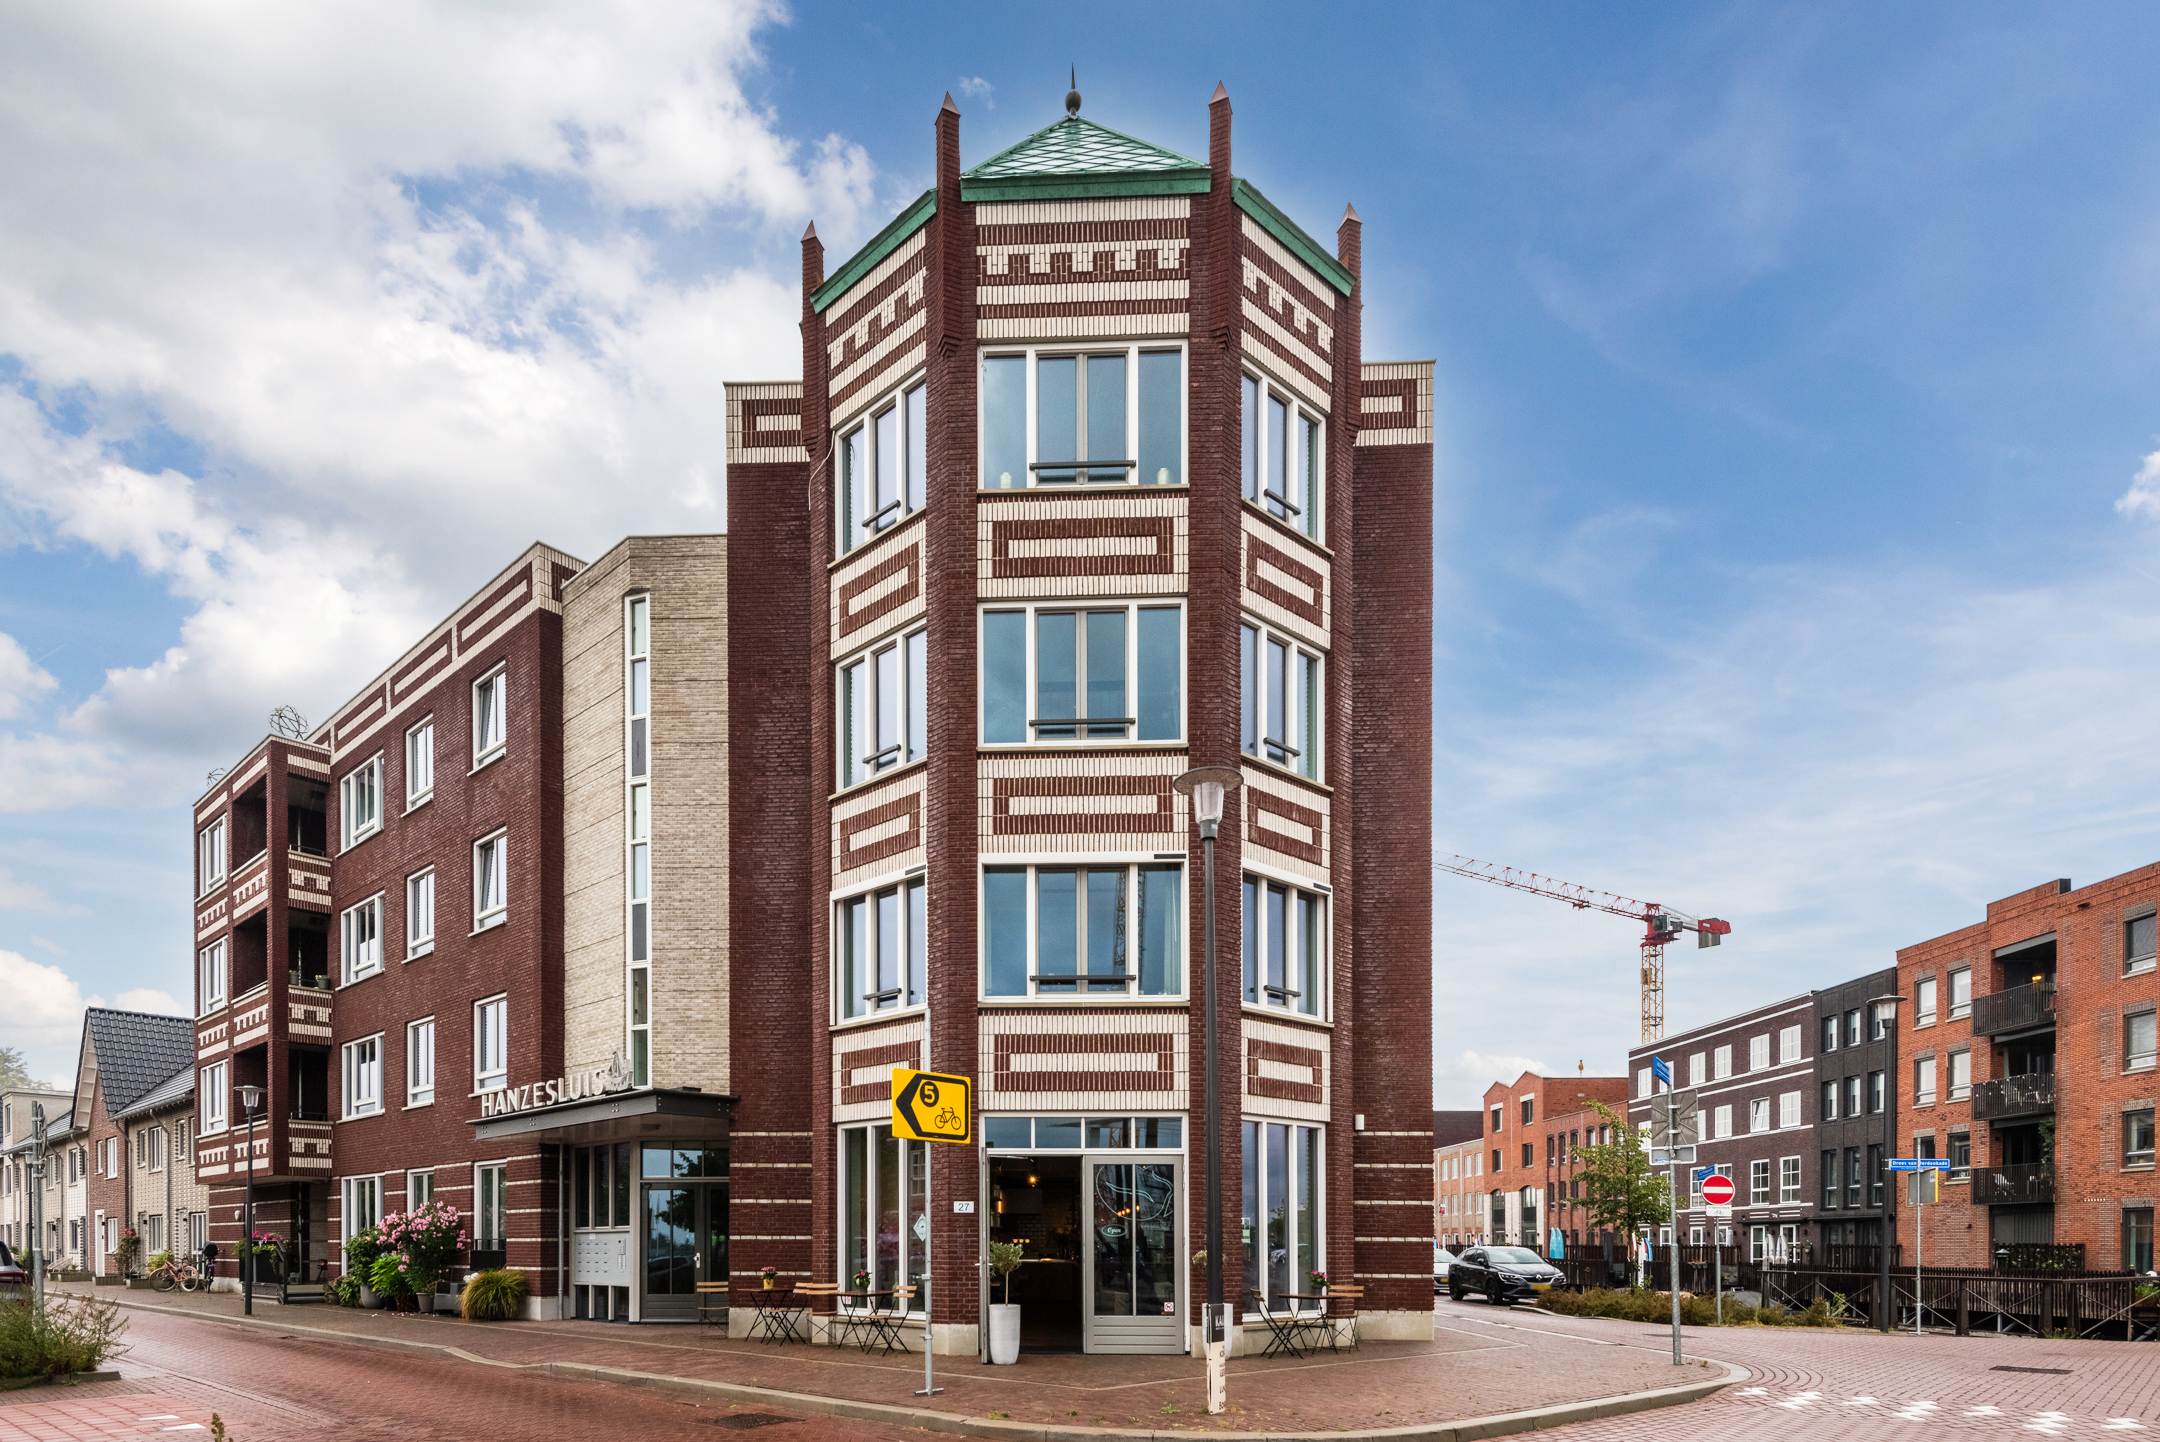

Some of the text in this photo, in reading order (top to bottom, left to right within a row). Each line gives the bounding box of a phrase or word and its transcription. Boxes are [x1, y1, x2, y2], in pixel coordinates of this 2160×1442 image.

[481, 1069, 606, 1117] HANZESLUIS
[924, 1086, 935, 1104] 5
[958, 1202, 970, 1211] 27
